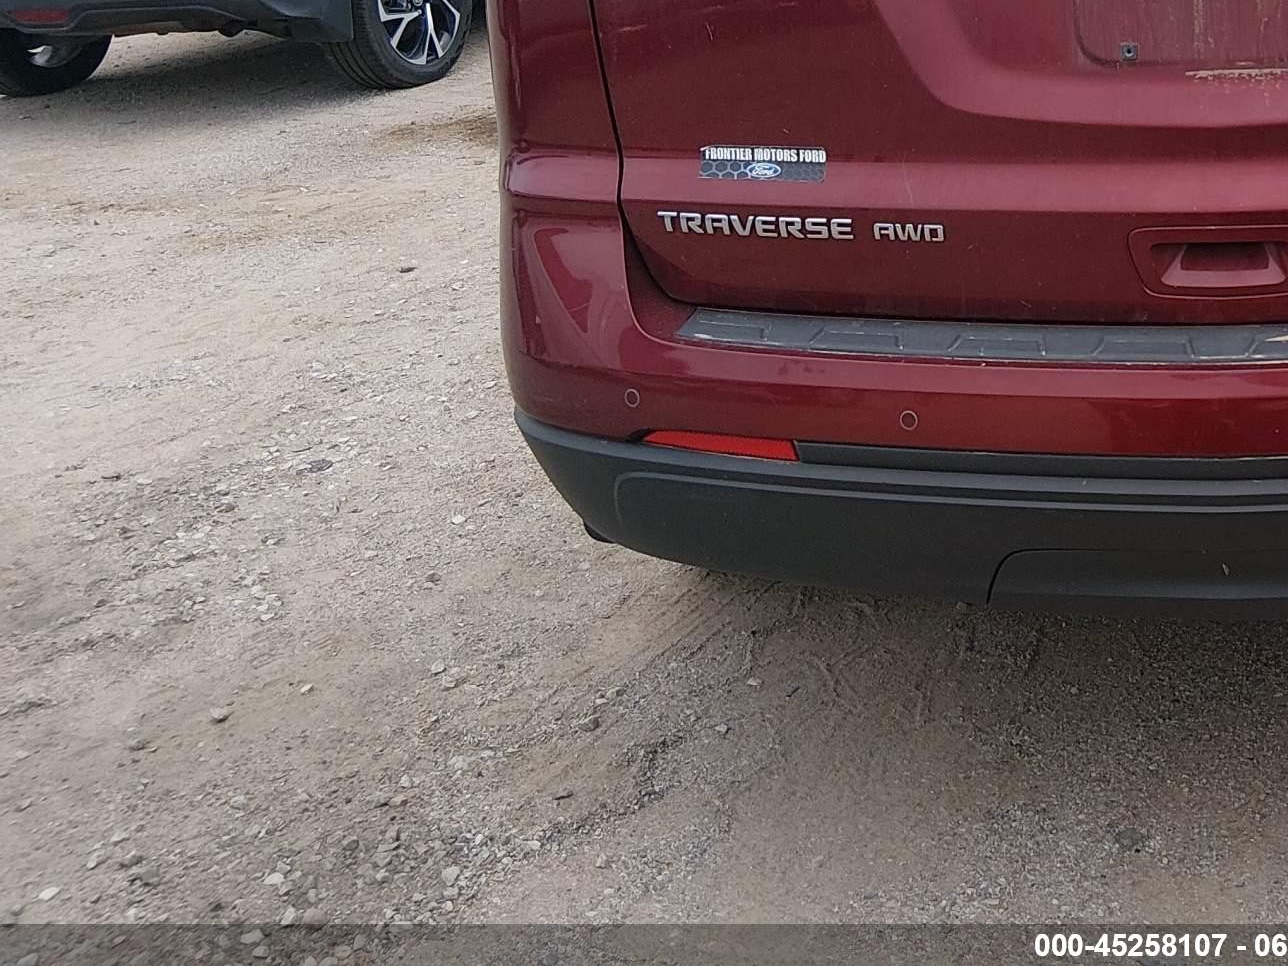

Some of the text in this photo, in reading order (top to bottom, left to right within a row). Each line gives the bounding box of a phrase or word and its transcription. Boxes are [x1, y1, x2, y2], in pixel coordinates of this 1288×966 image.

[705, 147, 826, 163] FRONTIER MOTORS FORD
[657, 210, 945, 242] TRAVERSE AWD
